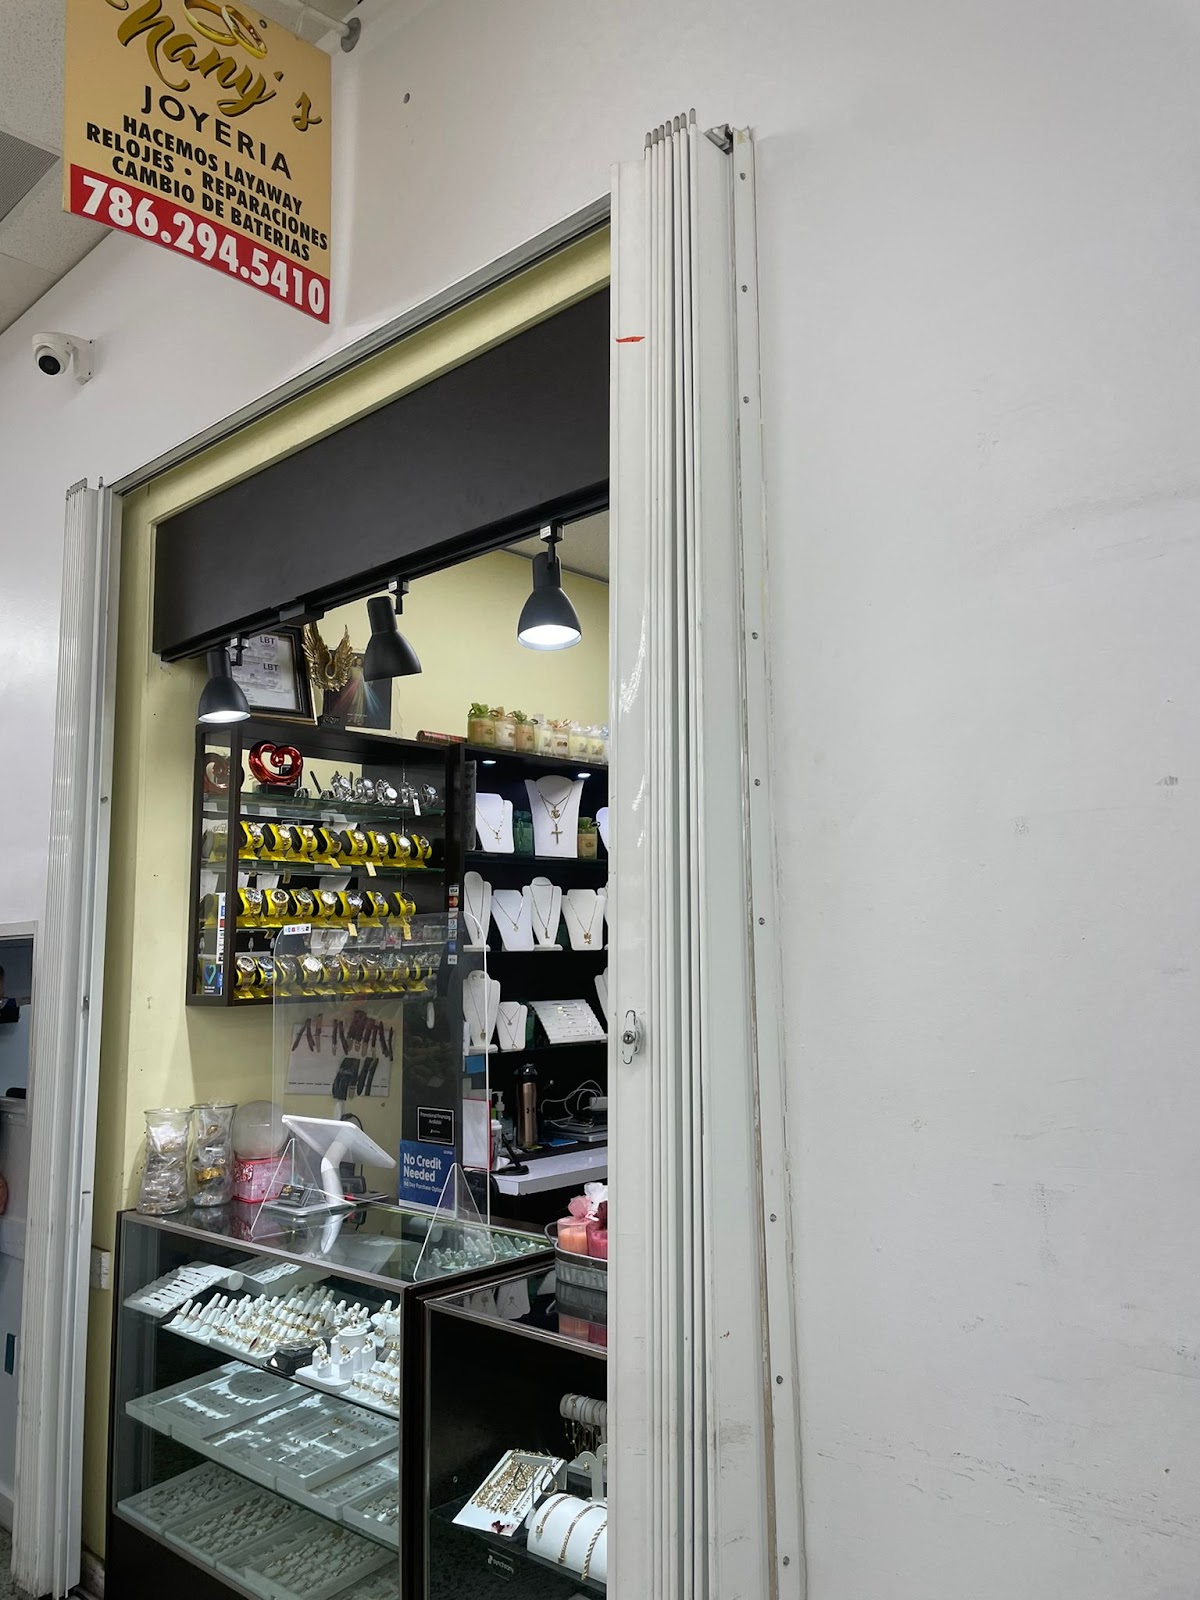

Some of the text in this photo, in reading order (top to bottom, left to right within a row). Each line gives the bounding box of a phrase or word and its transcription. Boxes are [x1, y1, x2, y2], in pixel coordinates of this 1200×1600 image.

[123, 115, 302, 216] HACEMOS LAYAWAY
[141, 85, 292, 180] JOYERIA
[87, 122, 328, 250] RELOJES REPARACIONES
[112, 156, 310, 262] CAMBIO DE BATERIAS
[82, 175, 325, 315] 786.294.5410
[260, 636, 275, 645] LBT
[263, 663, 278, 671] LBT
[403, 1152, 442, 1170] No Credit
[403, 1166, 436, 1182] Needed
